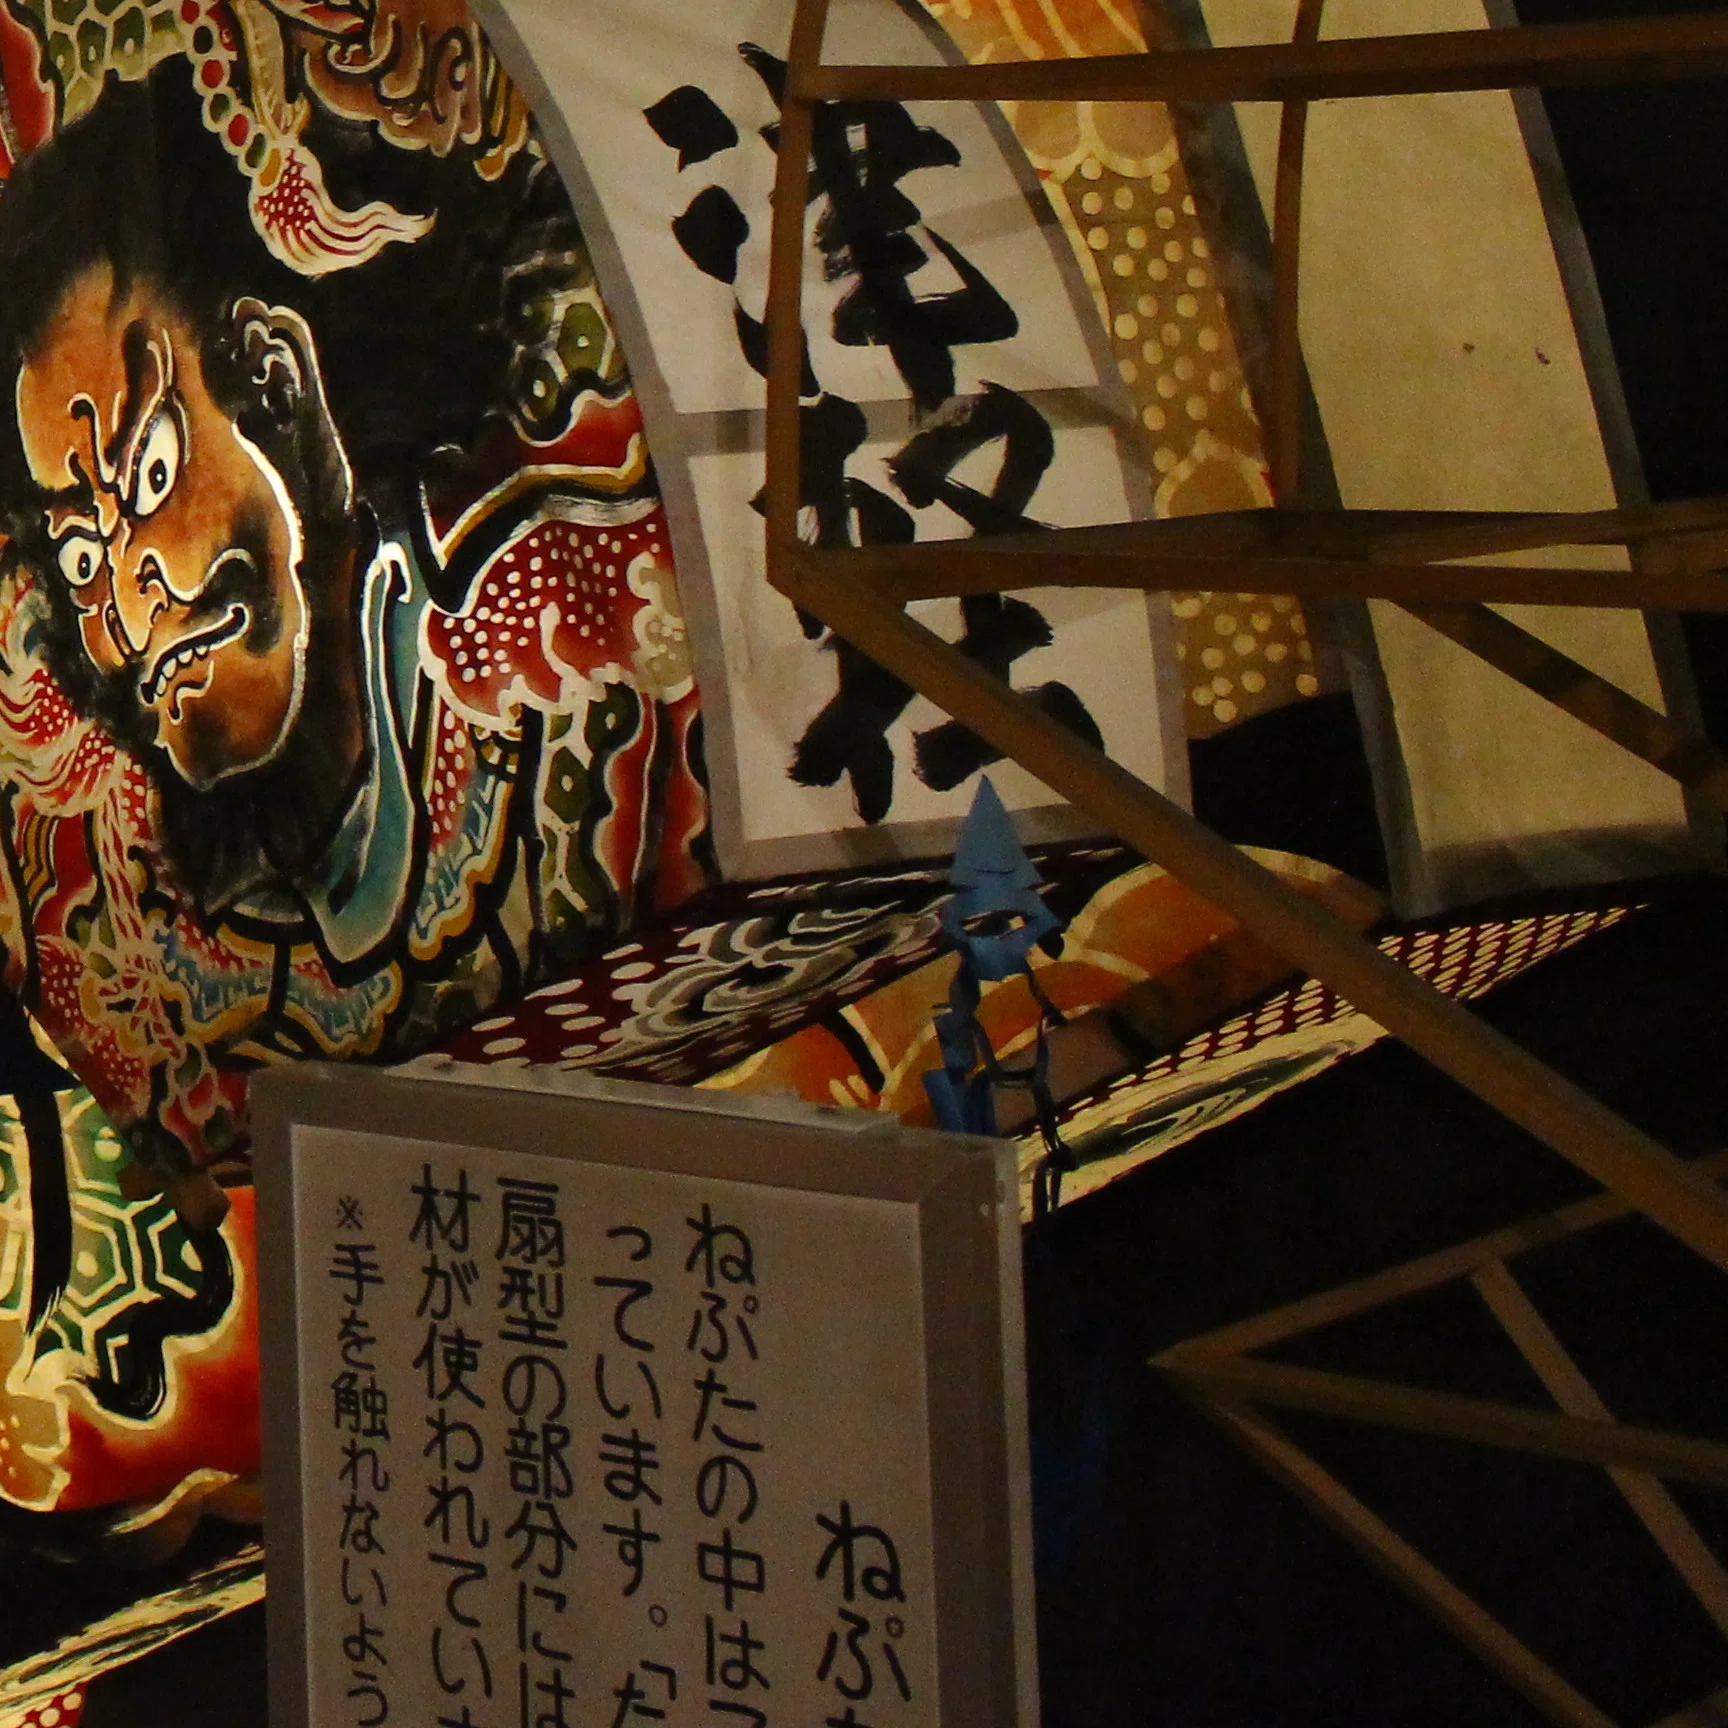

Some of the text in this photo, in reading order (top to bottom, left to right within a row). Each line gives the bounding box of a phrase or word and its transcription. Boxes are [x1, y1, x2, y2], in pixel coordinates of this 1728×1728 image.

[408, 1162, 493, 1728] 材が使われてい
[494, 1177, 578, 1728] 扇型の部分には
[815, 1500, 912, 1728] ねぷ
